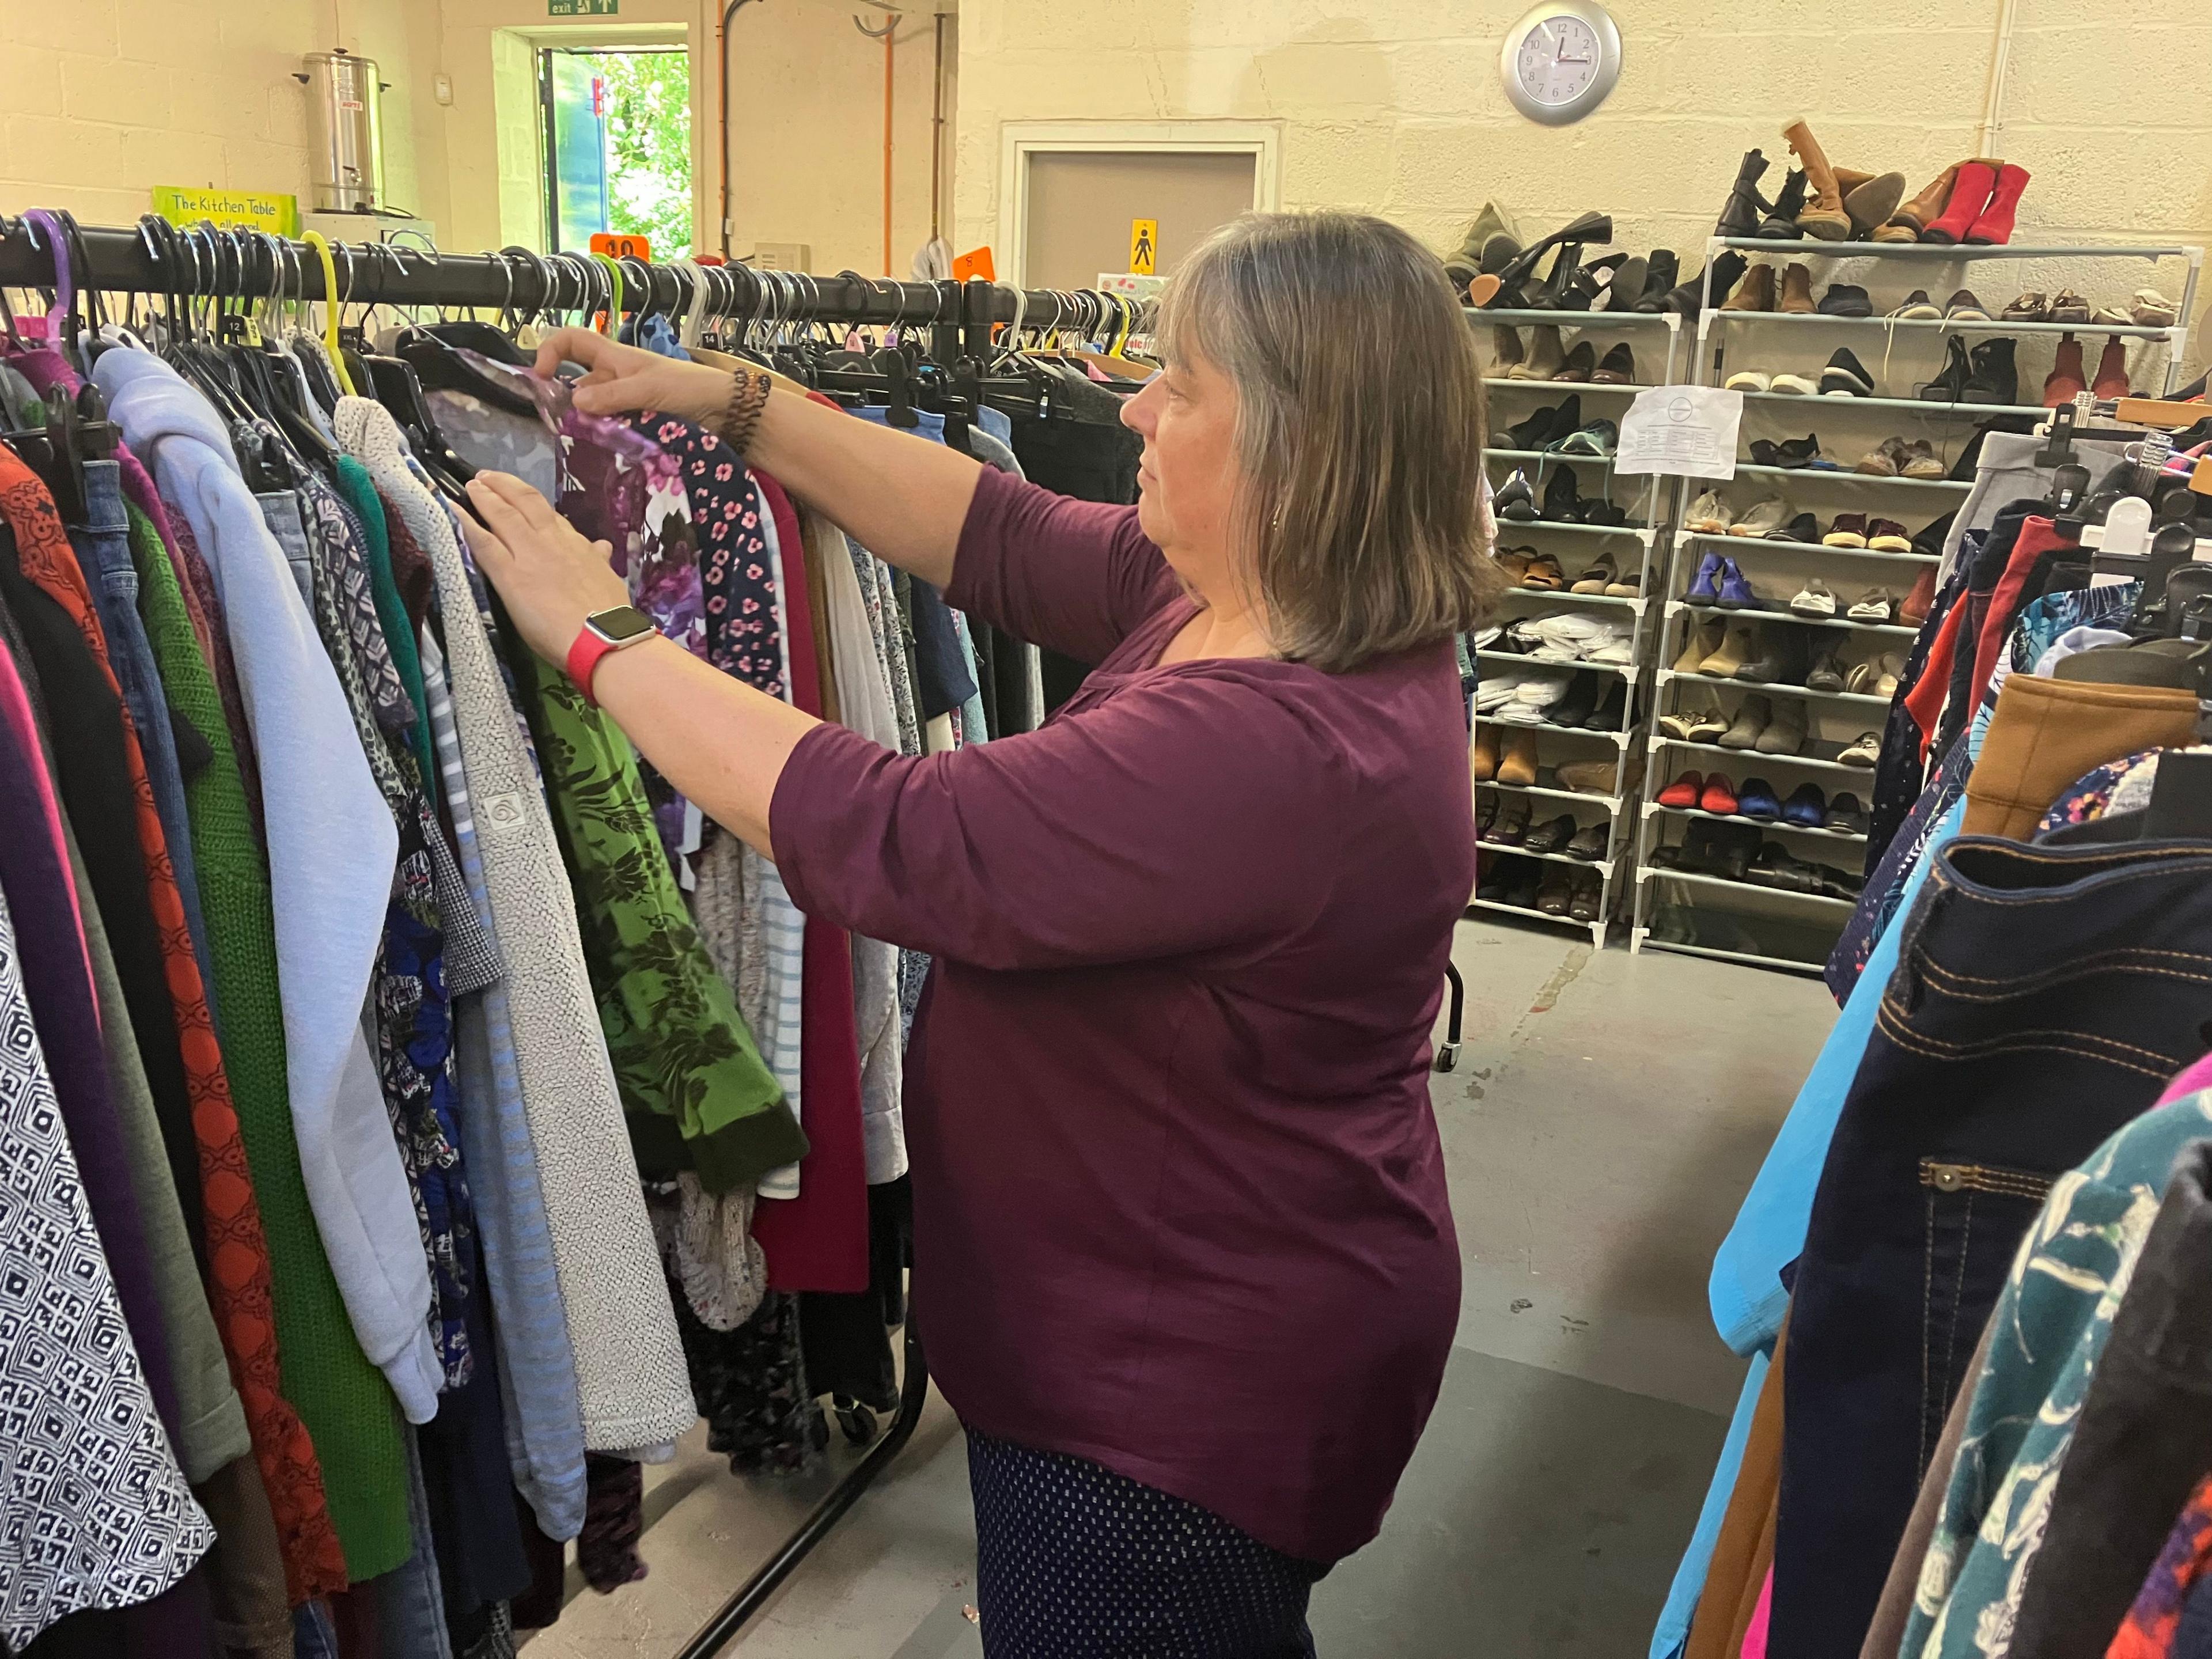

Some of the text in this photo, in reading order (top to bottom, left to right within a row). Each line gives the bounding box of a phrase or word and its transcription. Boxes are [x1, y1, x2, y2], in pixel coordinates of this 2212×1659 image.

[552, 3, 571, 14] exit
[1557, 23, 1567, 33] 12
[1574, 27, 1578, 37] 1
[1531, 40, 1540, 50] 10
[1583, 39, 1590, 49] 2
[1526, 56, 1532, 66] 9
[1586, 55, 1592, 65] 3
[1528, 71, 1535, 82] 8
[1580, 71, 1586, 81] 4
[1538, 84, 1544, 93] 7
[1552, 88, 1559, 97] 6
[1567, 83, 1574, 93] 5
[172, 195, 275, 215] The Kitchen Table
[605, 239, 634, 259] 10
[965, 256, 973, 267] 8
[229, 323, 240, 331] 12
[522, 336, 528, 344] L
[704, 335, 715, 344] 14
